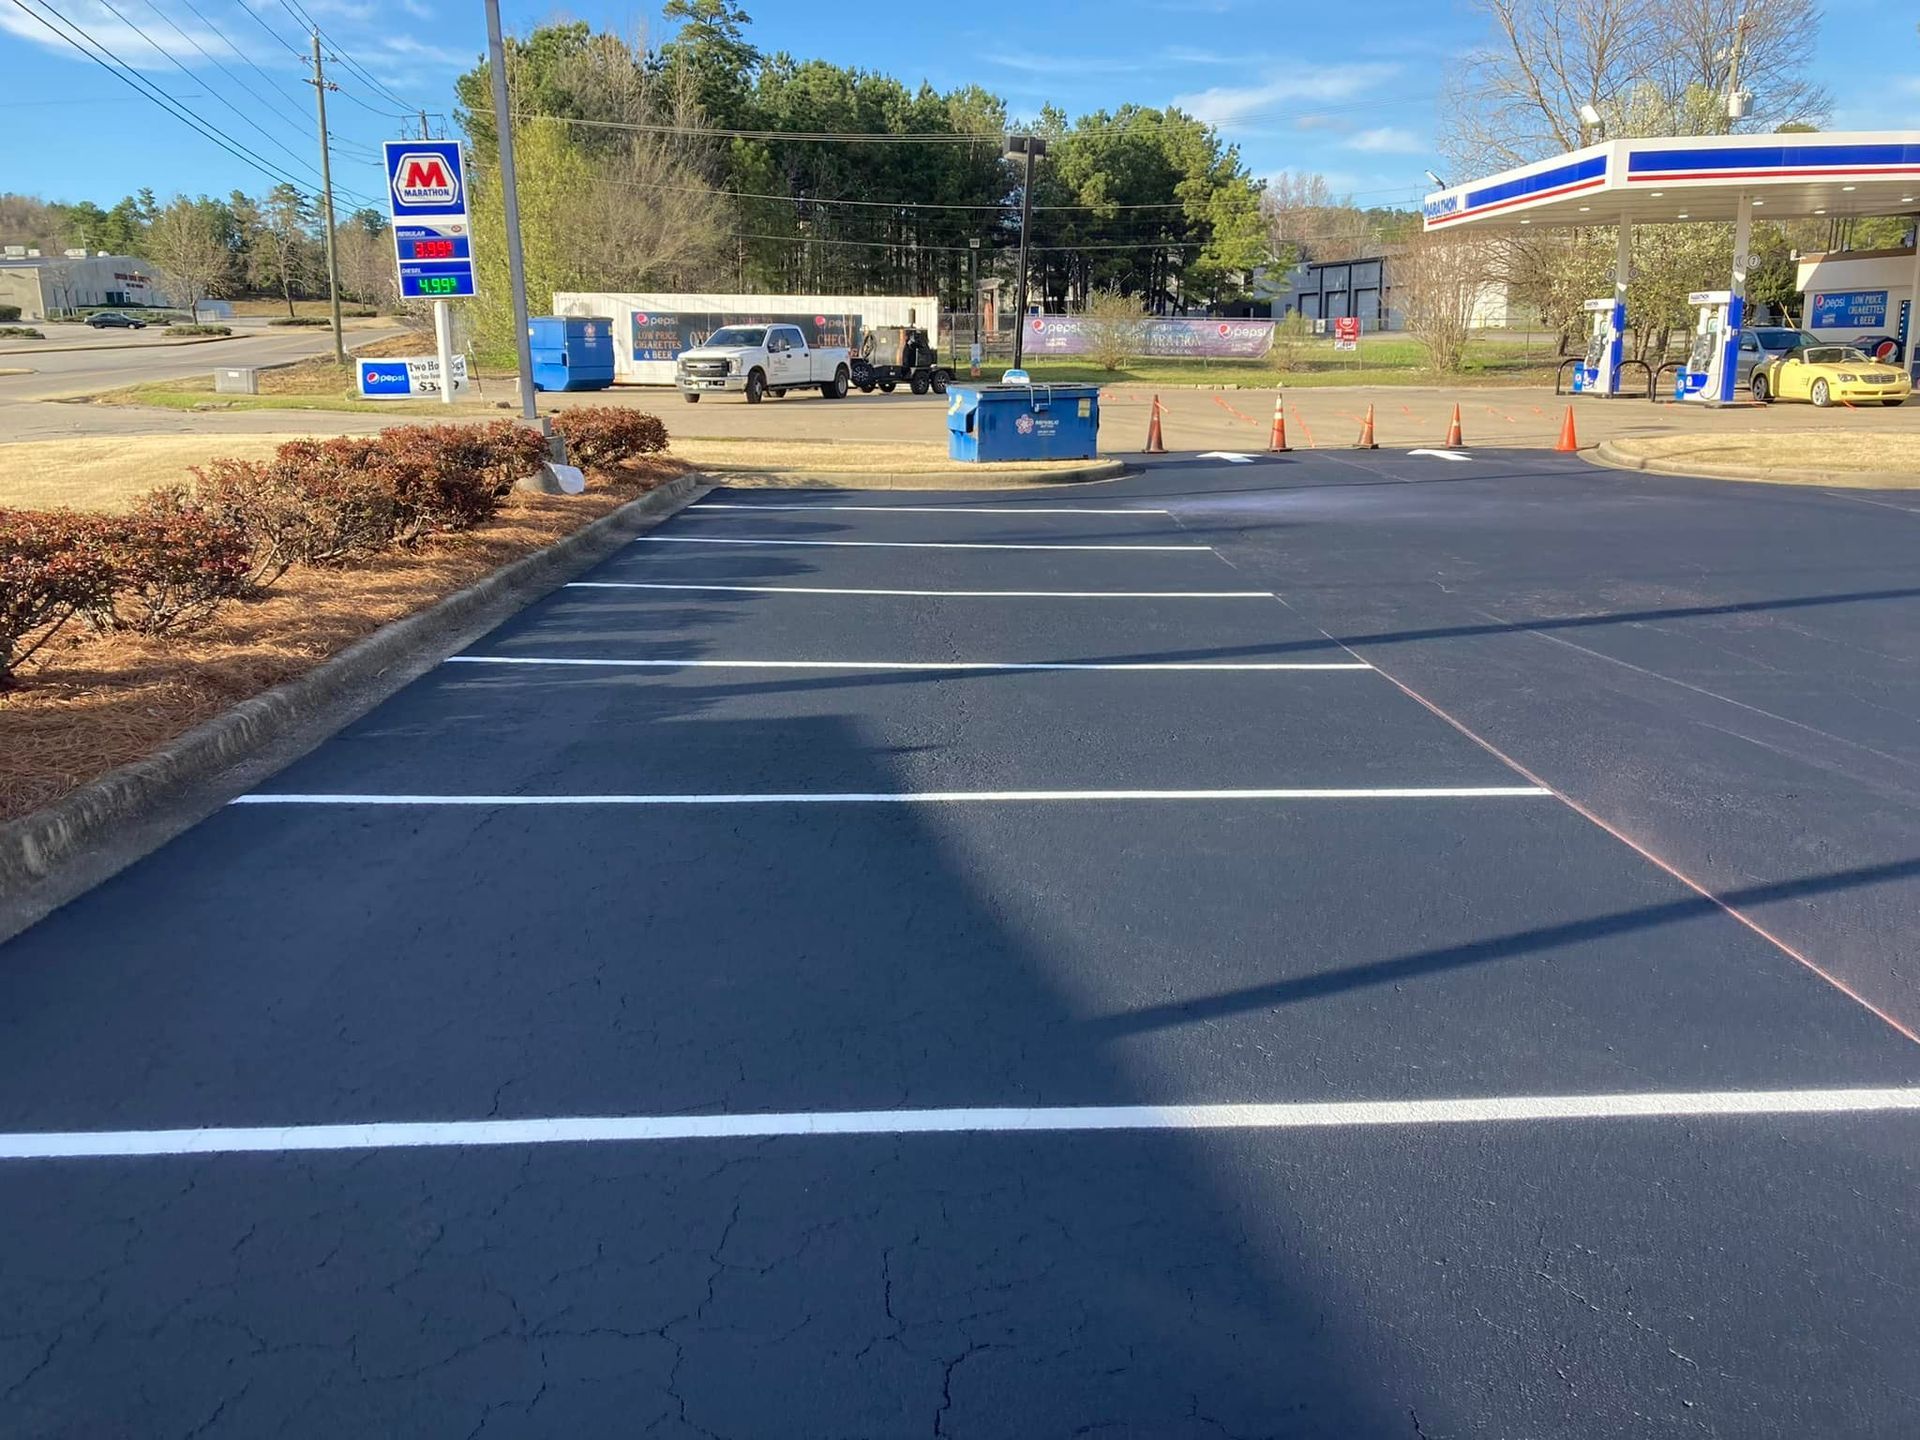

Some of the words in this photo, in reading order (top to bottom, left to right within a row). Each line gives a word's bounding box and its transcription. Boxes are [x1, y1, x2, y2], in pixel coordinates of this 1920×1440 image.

[404, 188, 450, 197] MARATHON
[1424, 195, 1458, 217] MARATHON
[1824, 297, 1846, 309] pepsi
[650, 315, 680, 326] pepsi
[1860, 315, 1876, 325] BEER
[1048, 322, 1080, 334] pepsi
[1234, 326, 1266, 338] pepsi
[634, 340, 682, 349] CIGARETTES
[652, 350, 673, 359] BEER
[408, 362, 426, 372] Two
[427, 360, 439, 371] Ho
[380, 374, 405, 383] pepsi
